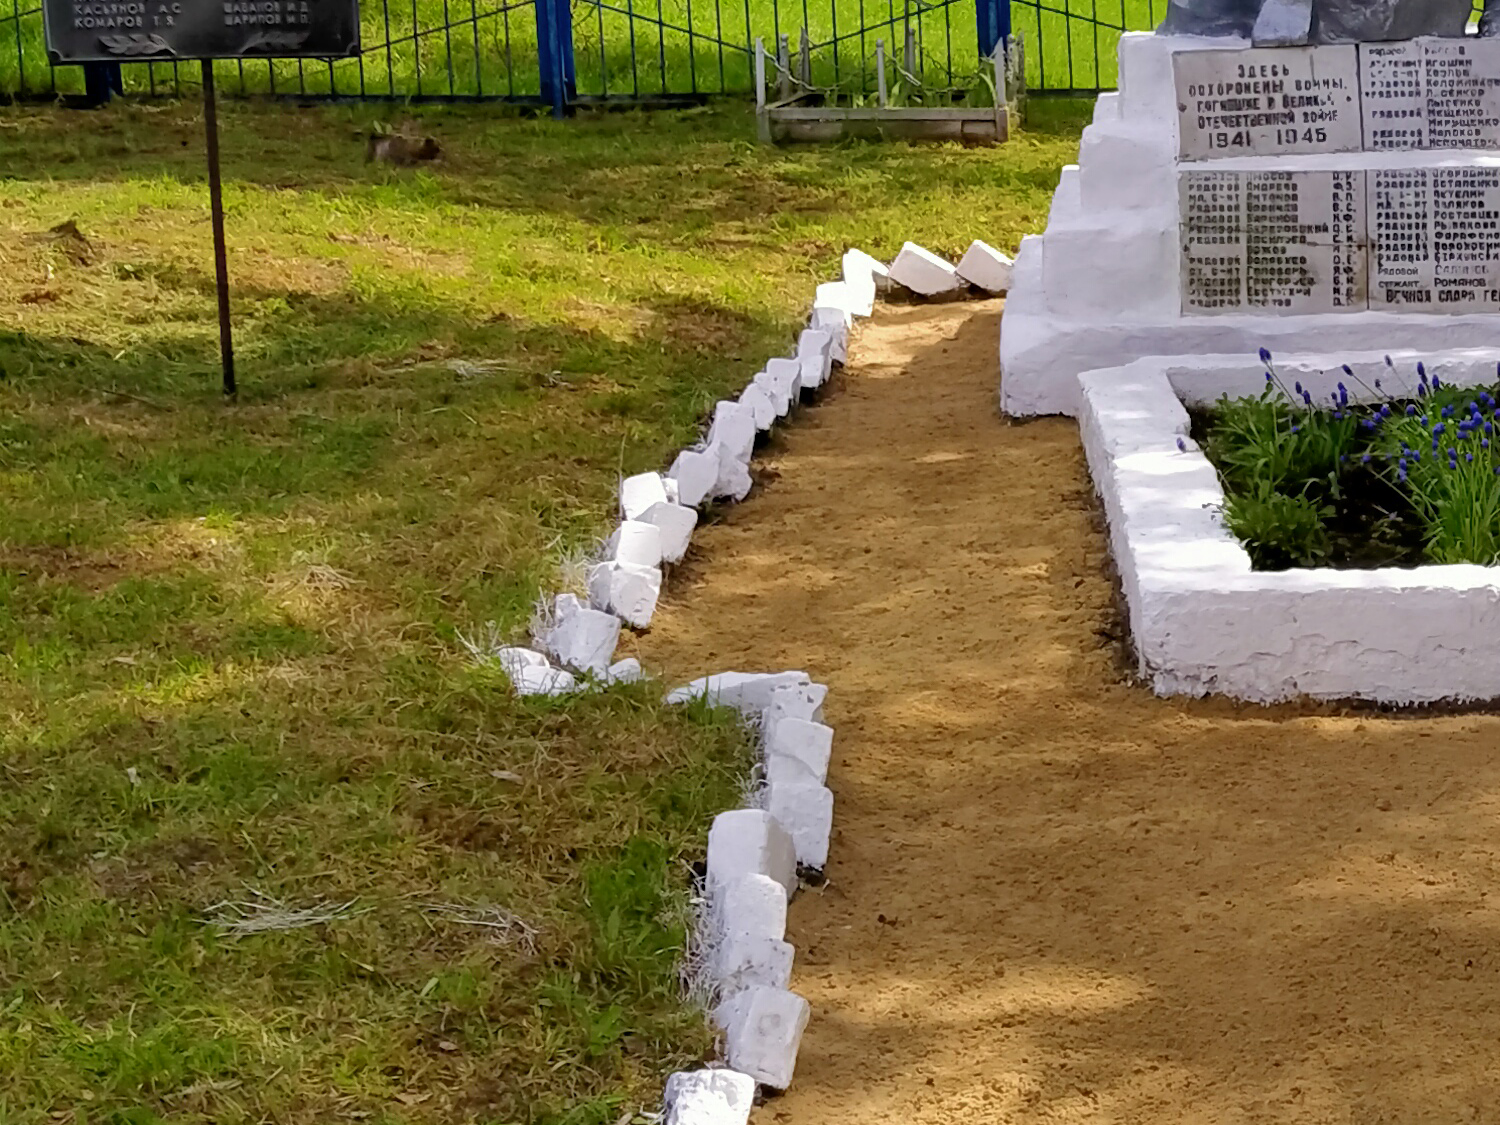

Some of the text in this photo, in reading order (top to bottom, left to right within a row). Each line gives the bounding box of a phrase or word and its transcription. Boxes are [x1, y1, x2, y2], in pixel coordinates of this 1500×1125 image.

[73, 3, 145, 15] КАСЬЯНОВ
[74, 17, 142, 28] КОМАРОВ
[1238, 64, 1290, 78] ЗДЕСЬ
[1188, 80, 1284, 97] ПОХОРОНЕНЫ
[1208, 131, 1251, 149] 1941
[1434, 278, 1486, 287] РОМАНОВ
